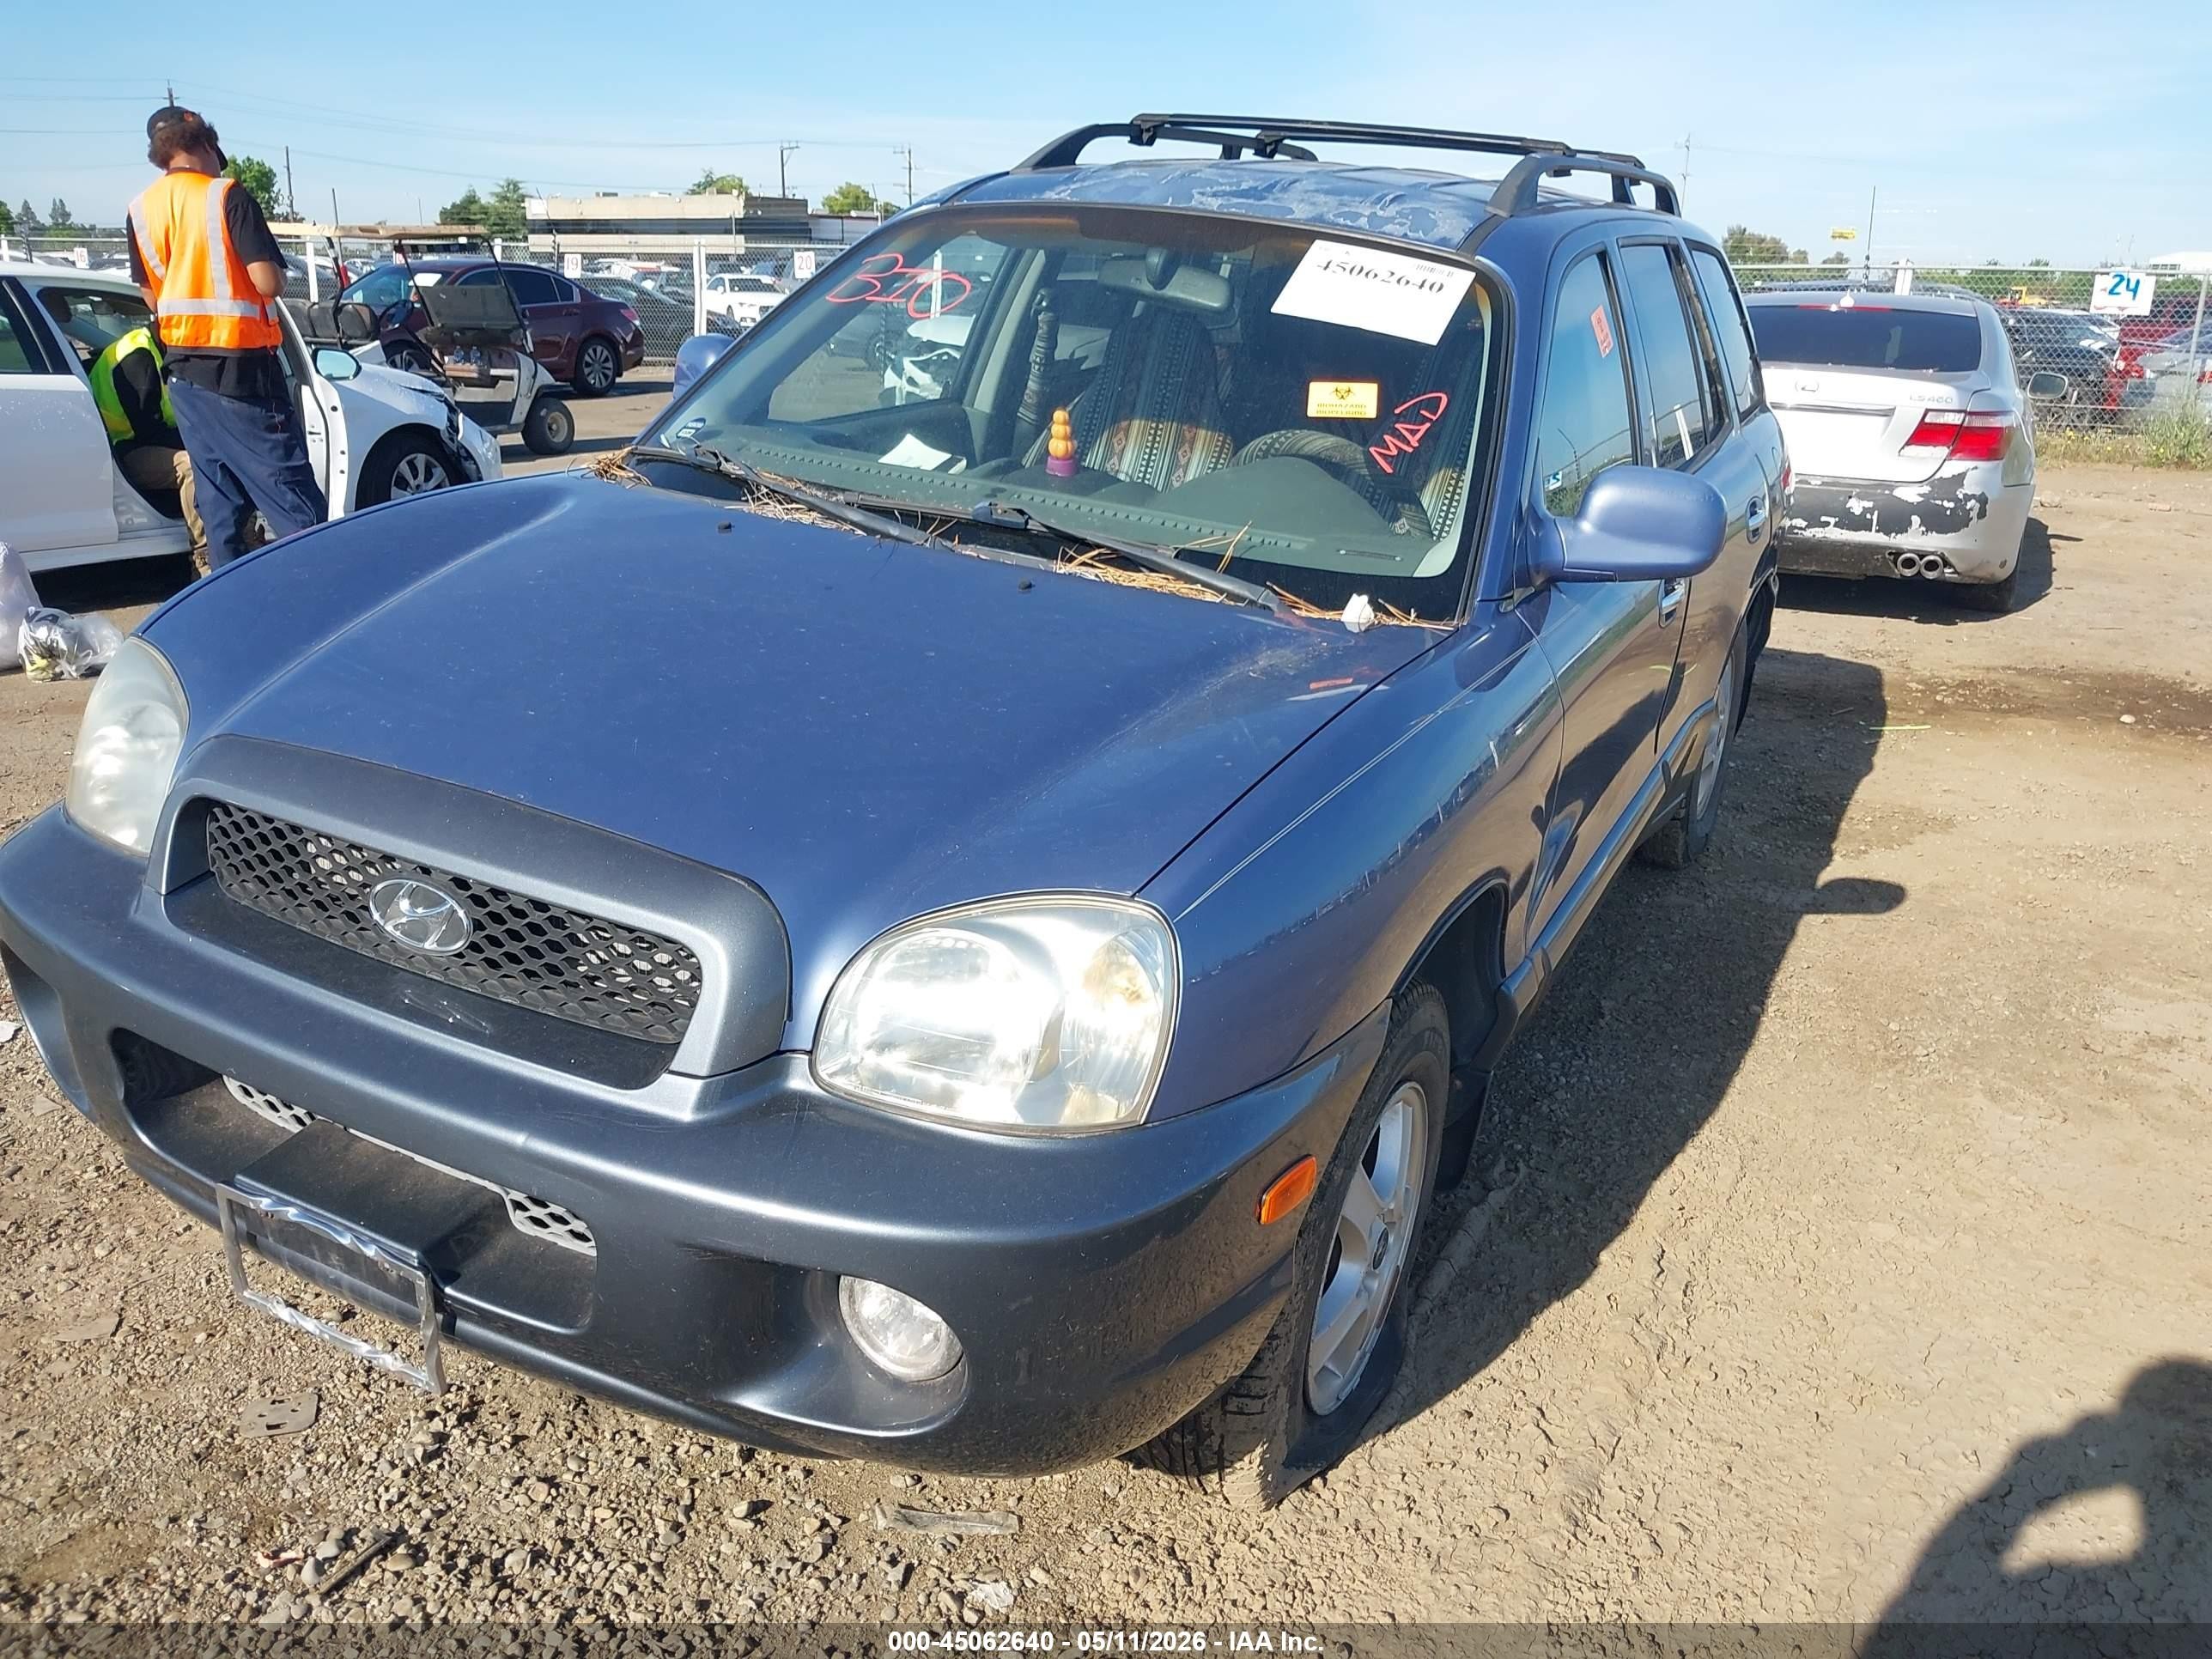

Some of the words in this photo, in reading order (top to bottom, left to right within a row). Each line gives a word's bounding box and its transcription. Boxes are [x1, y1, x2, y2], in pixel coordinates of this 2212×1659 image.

[567, 257, 579, 270] 19
[797, 255, 812, 270] 20
[1316, 259, 1444, 294] 45062640
[2107, 272, 2141, 301] 24
[1368, 392, 1449, 473] MAD
